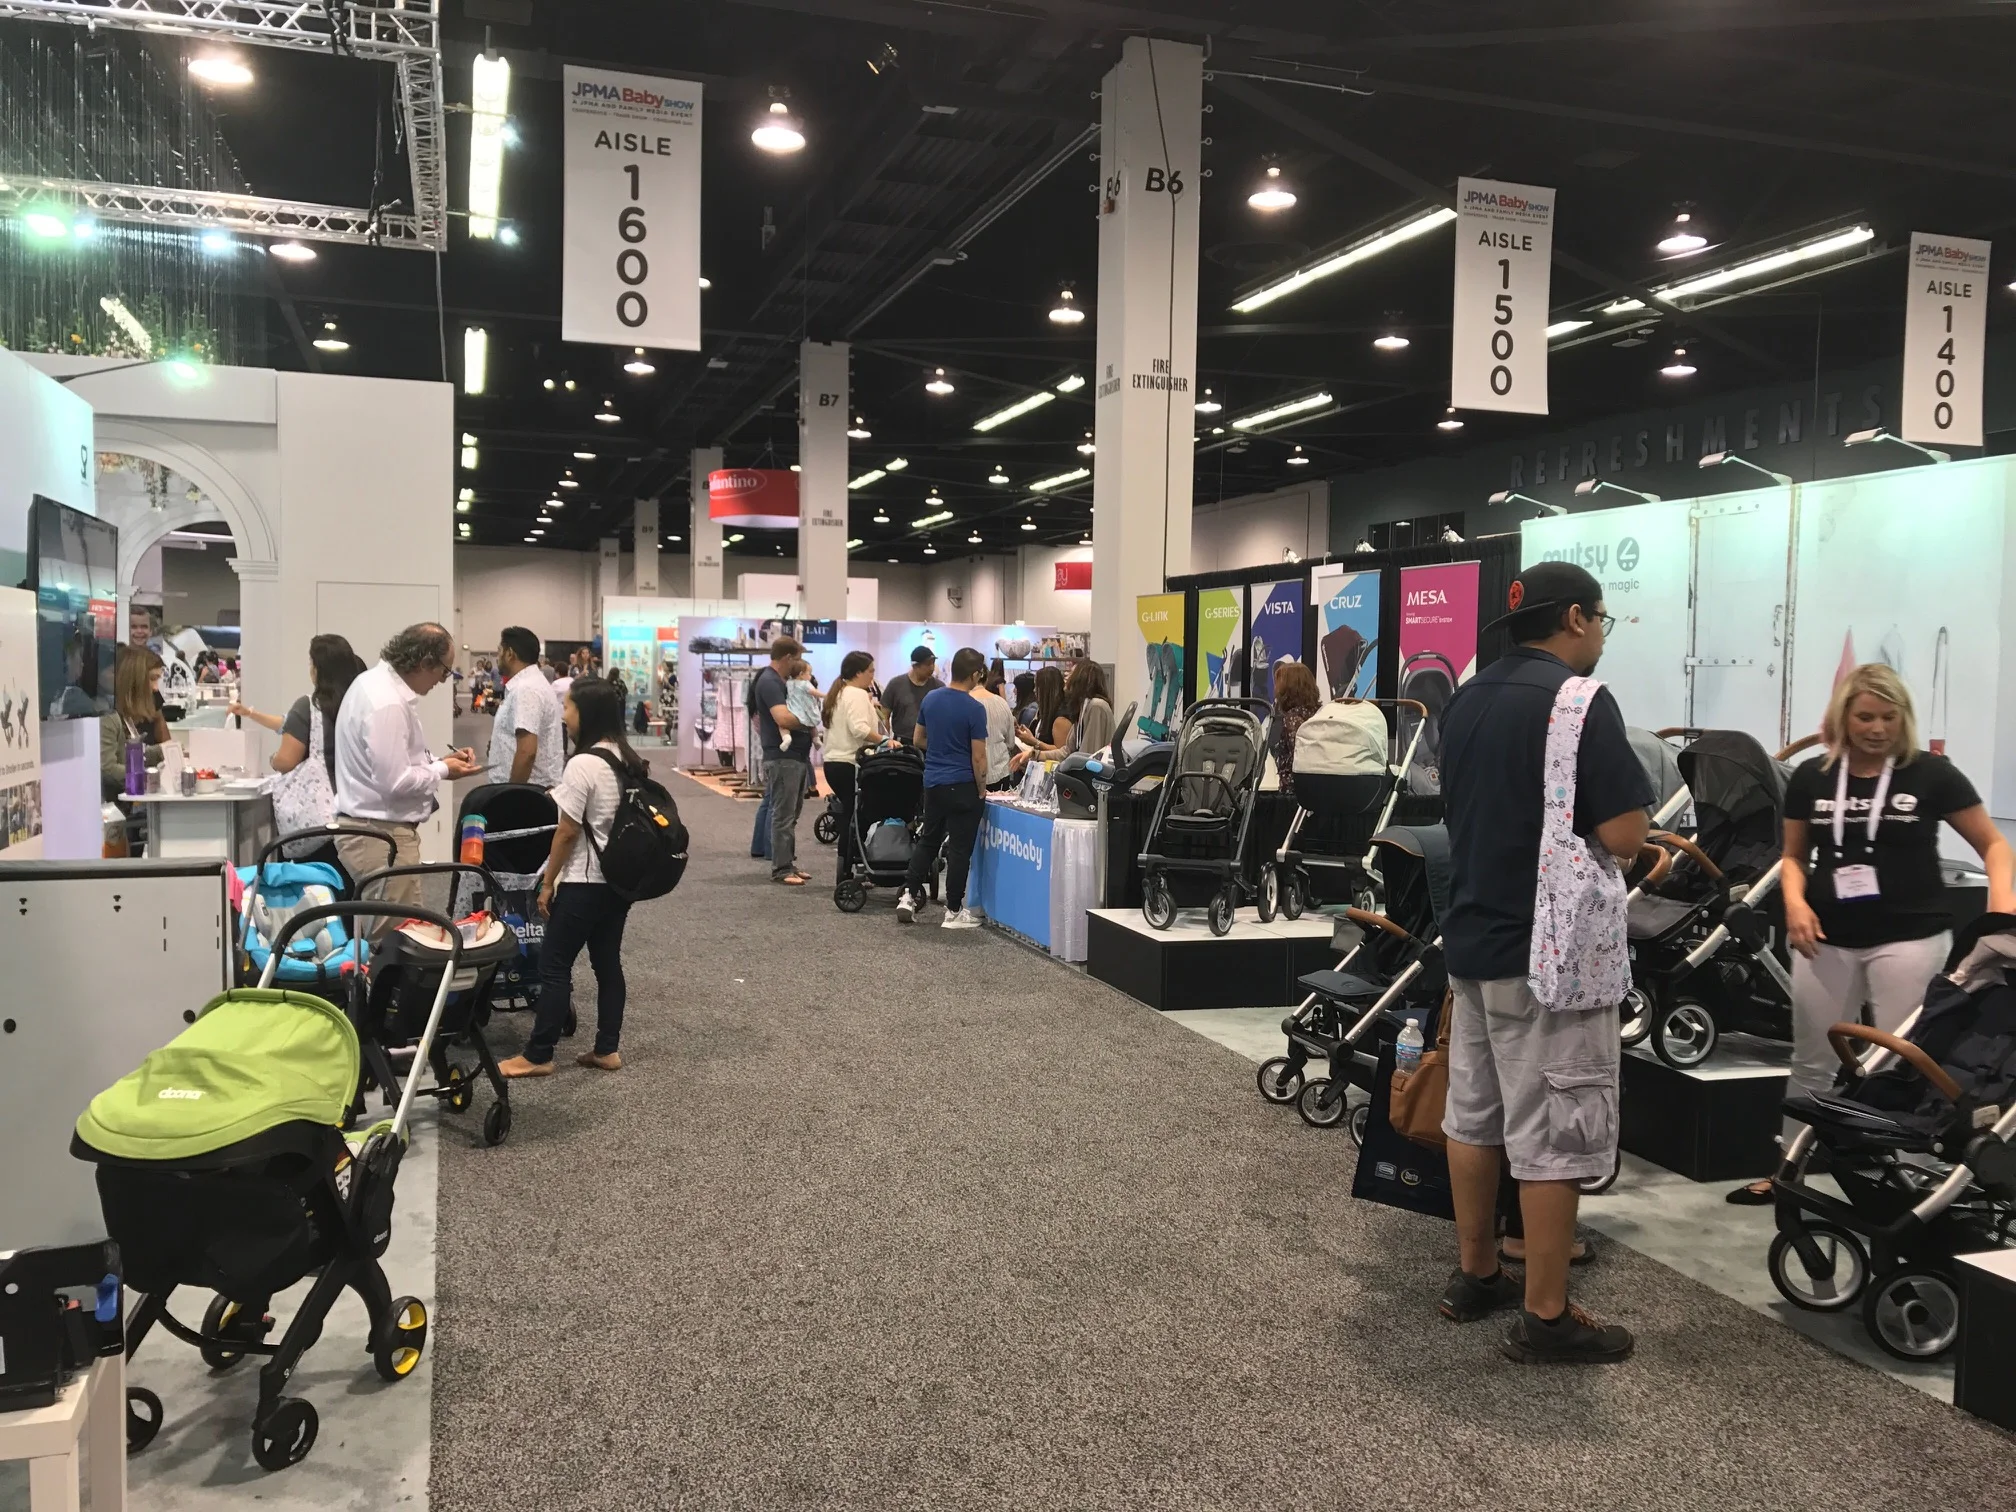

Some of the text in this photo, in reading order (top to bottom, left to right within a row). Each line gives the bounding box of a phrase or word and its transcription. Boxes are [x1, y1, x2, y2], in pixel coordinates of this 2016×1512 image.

[594, 130, 672, 157] AISLE
[1145, 167, 1184, 195] B6
[1478, 230, 1533, 251] AISLE
[1927, 280, 1972, 298] AISLE
[1152, 358, 1170, 374] FIRE
[1132, 374, 1188, 392] EXTINGUISHER
[819, 393, 840, 407] B7
[1510, 384, 1883, 488] REFRESHMENTS
[1608, 578, 1640, 593] magic
[1330, 594, 1362, 610] CRUZ
[1406, 589, 1448, 606] MESA
[1205, 606, 1241, 620] G-SERIES
[1264, 601, 1295, 615] VISTA
[806, 626, 827, 635] LAIT
